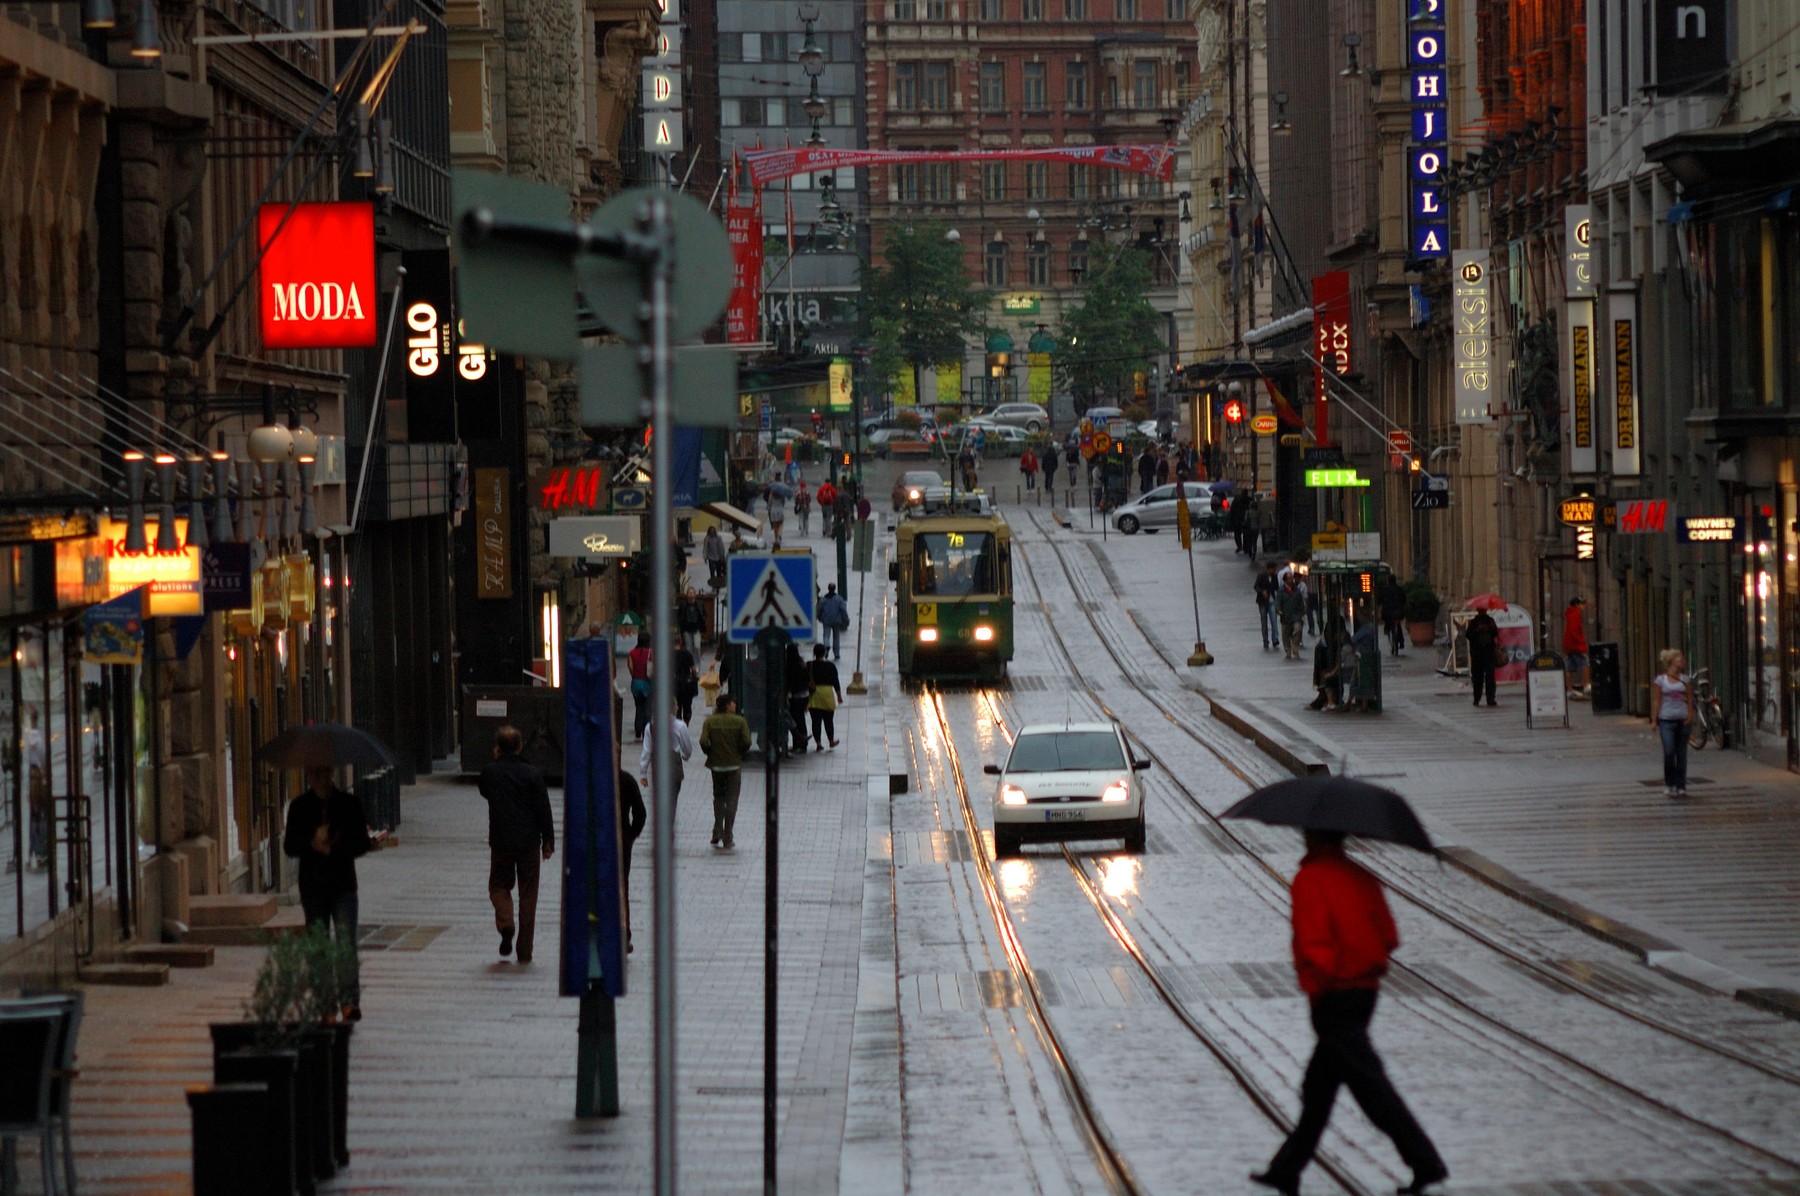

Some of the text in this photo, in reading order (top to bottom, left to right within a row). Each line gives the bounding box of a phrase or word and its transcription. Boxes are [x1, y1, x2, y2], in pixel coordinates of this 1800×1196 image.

[271, 281, 366, 321] MODA
[408, 303, 439, 376] GLO
[814, 343, 839, 354] Aktia
[1456, 288, 1489, 391] aleksi
[1574, 328, 1590, 447] DRESSMANN
[1617, 321, 1633, 447] DRESSMANN
[541, 466, 601, 511] H&M
[1622, 500, 1668, 534] H&M
[1686, 518, 1736, 529] WAYNE'S
[1688, 529, 1733, 540] COFFEE
[151, 582, 193, 592] olutions
